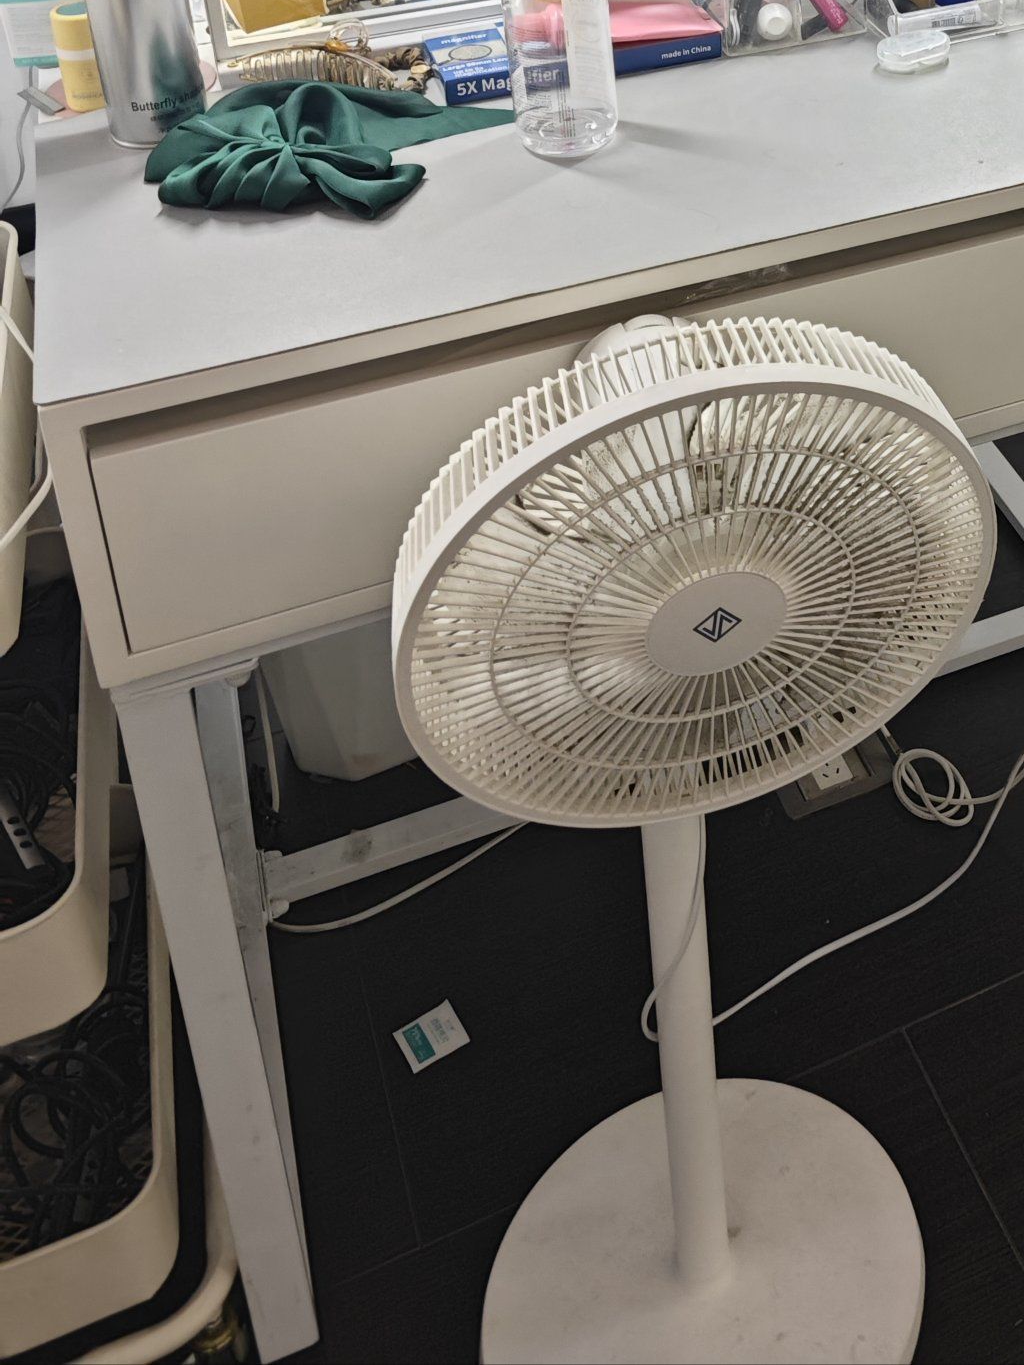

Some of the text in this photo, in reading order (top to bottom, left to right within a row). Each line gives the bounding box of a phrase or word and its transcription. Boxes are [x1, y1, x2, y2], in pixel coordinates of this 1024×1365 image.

[440, 33, 488, 45] magnifier
[661, 44, 712, 60] made in China
[456, 80, 478, 96] 5X
[130, 96, 177, 112] Butterfly
